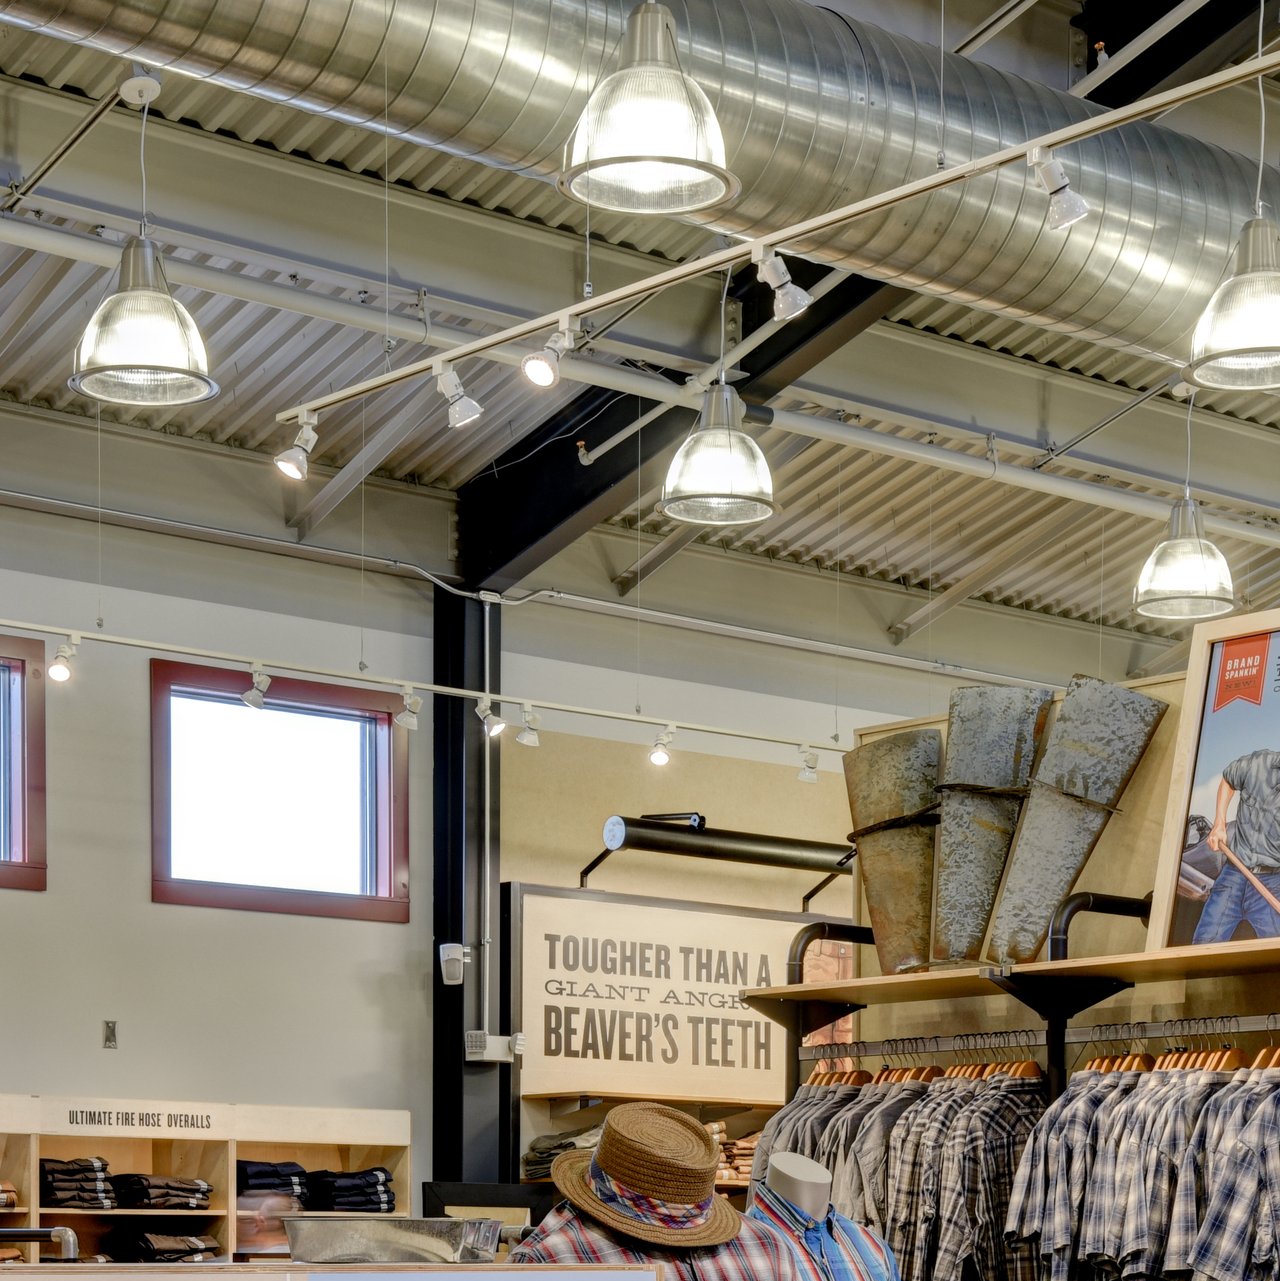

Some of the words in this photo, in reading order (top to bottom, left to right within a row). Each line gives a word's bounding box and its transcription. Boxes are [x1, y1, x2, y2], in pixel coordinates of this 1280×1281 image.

[1224, 666, 1259, 680] SPANKIN'
[1226, 656, 1260, 671] BRAND
[544, 933, 671, 980] TOUGHER
[678, 946, 748, 986] THAN
[756, 954, 772, 988] A
[544, 980, 650, 1002] GIANT
[660, 990, 751, 1010] ANGR
[544, 1004, 679, 1065] BEAVER'S
[686, 1015, 772, 1070] TEETH
[68, 1110, 113, 1126] ULTIMATE
[116, 1112, 136, 1126] FIRE
[138, 1112, 162, 1128] HOSE
[167, 1113, 211, 1129] OVERALLS
